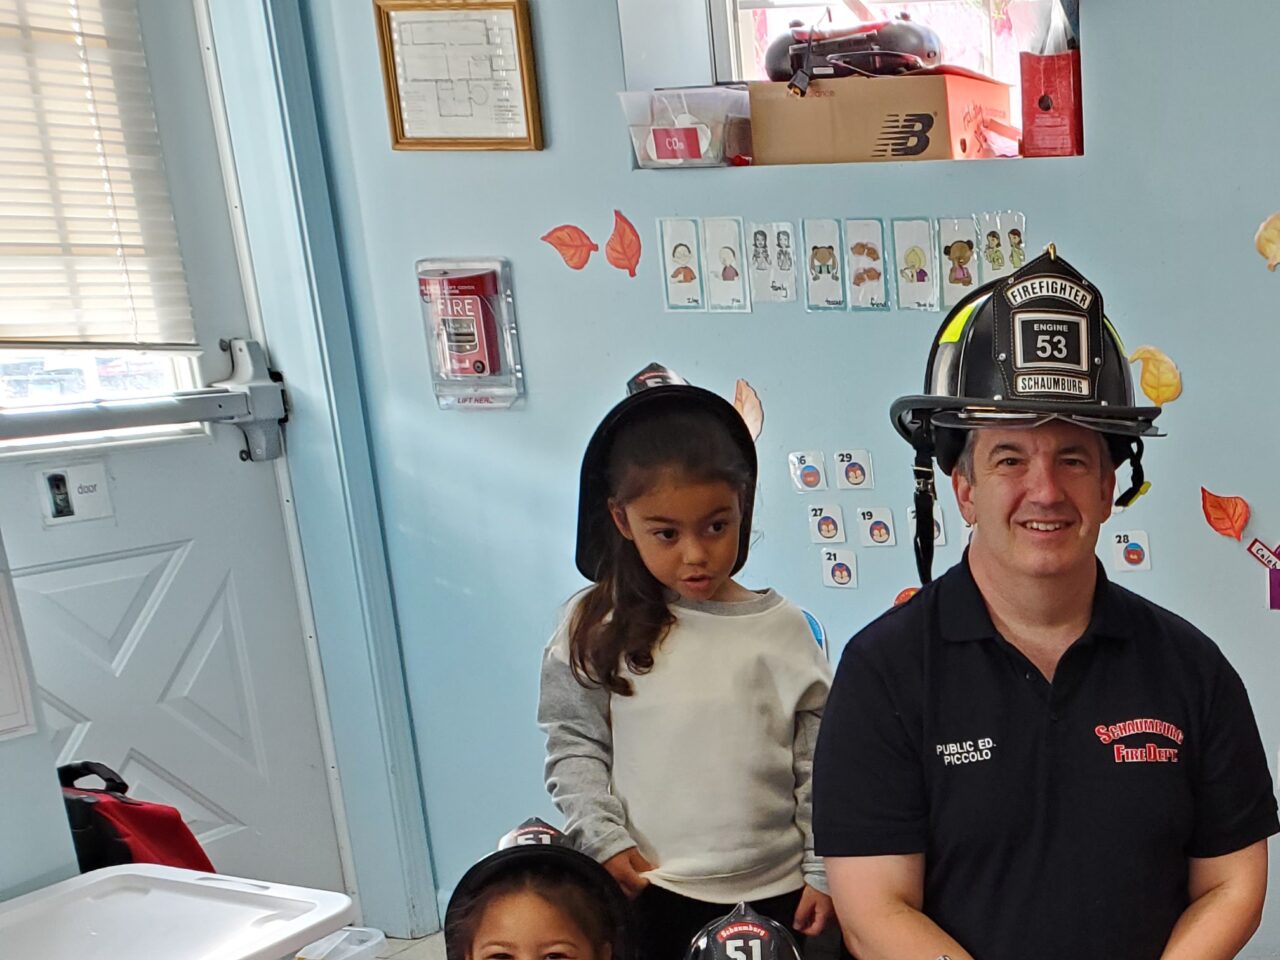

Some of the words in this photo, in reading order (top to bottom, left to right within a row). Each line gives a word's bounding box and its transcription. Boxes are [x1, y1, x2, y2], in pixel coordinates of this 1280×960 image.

[1010, 280, 1089, 308] FIREFIGHTER
[437, 299, 475, 316] FIRE
[1033, 323, 1069, 332] ENGINE
[1036, 335, 1068, 359] 53
[1021, 376, 1083, 394] SCHAUMBURG
[838, 453, 853, 463] 29
[77, 483, 97, 495] door
[811, 508, 823, 517] 27
[861, 511, 873, 520] 19
[1115, 534, 1130, 544] 28
[825, 552, 837, 561] 21
[936, 740, 974, 756] PUBLIC
[978, 738, 997, 750] ED.
[1114, 744, 1147, 763] FIRE
[944, 749, 991, 766] PICCOLO
[720, 924, 765, 939] Schaumburg
